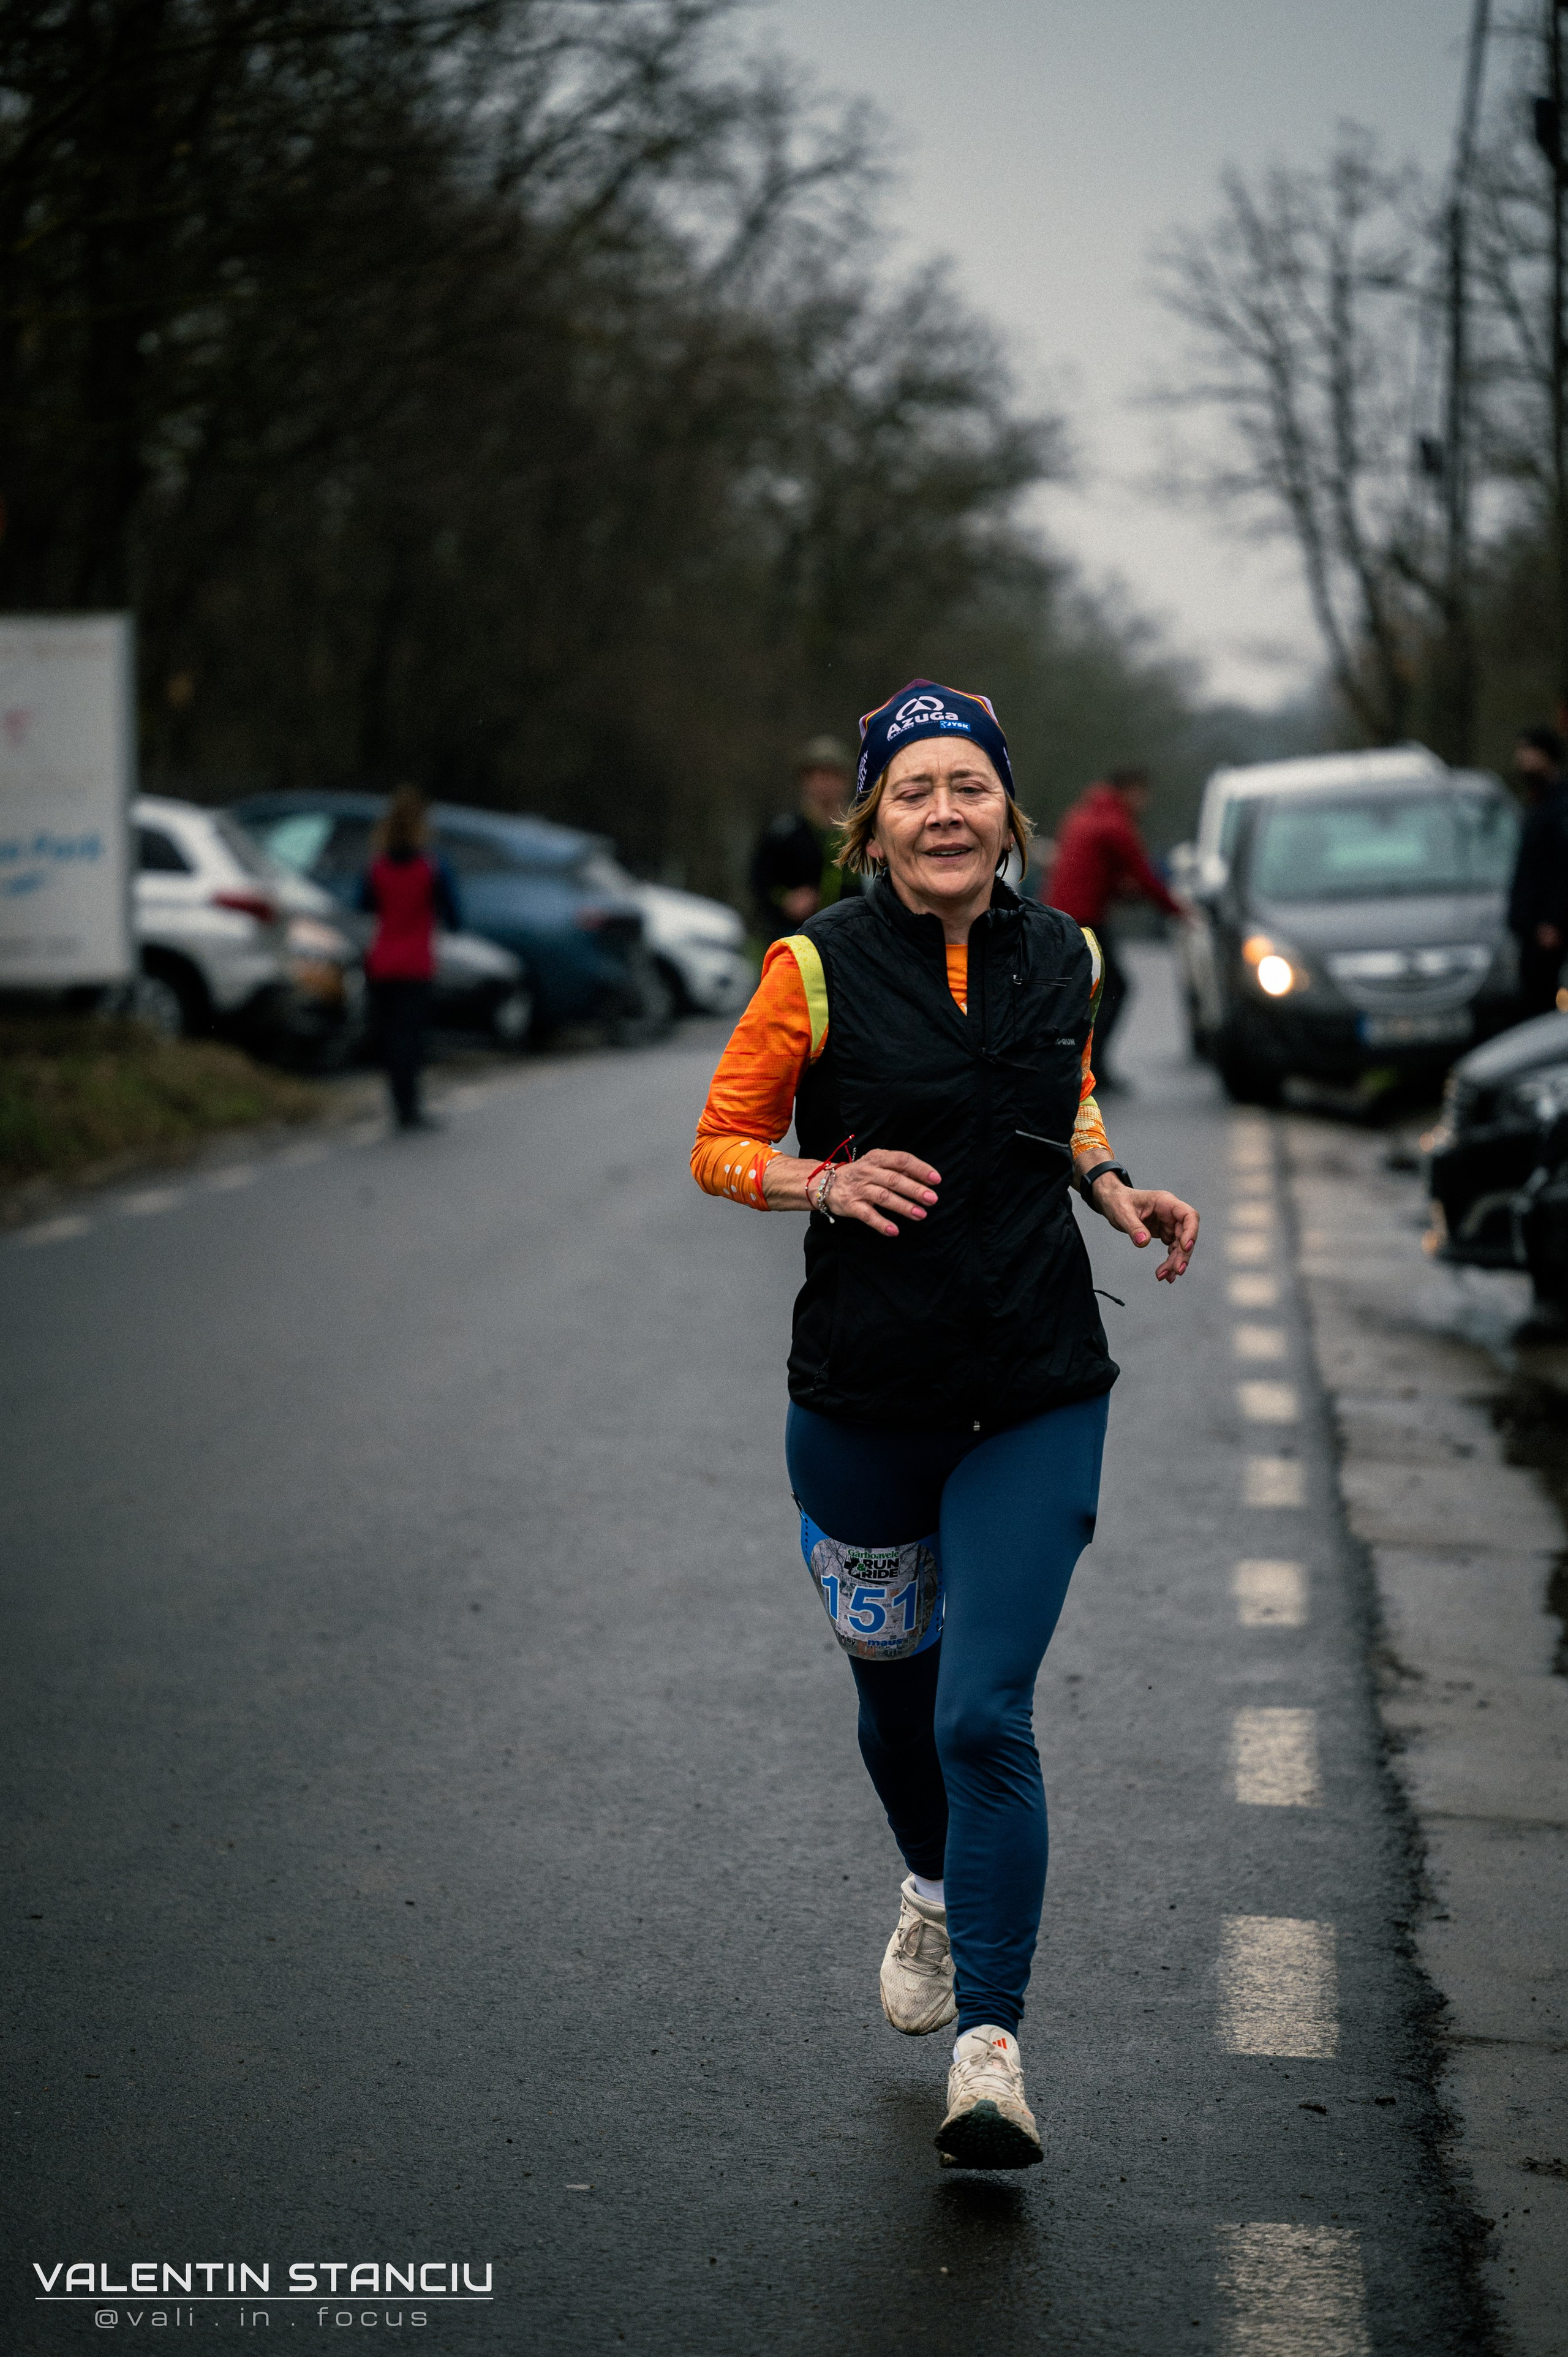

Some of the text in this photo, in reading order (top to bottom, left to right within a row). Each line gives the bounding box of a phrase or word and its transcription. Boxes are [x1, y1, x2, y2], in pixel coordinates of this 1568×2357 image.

[888, 725, 914, 741] TRAILRACE
[848, 1549, 899, 1559] Gârboavele
[863, 1558, 899, 1569] RUN
[862, 1568, 899, 1578] RIDE
[821, 1574, 918, 1634] 151
[847, 1637, 856, 1645] by
